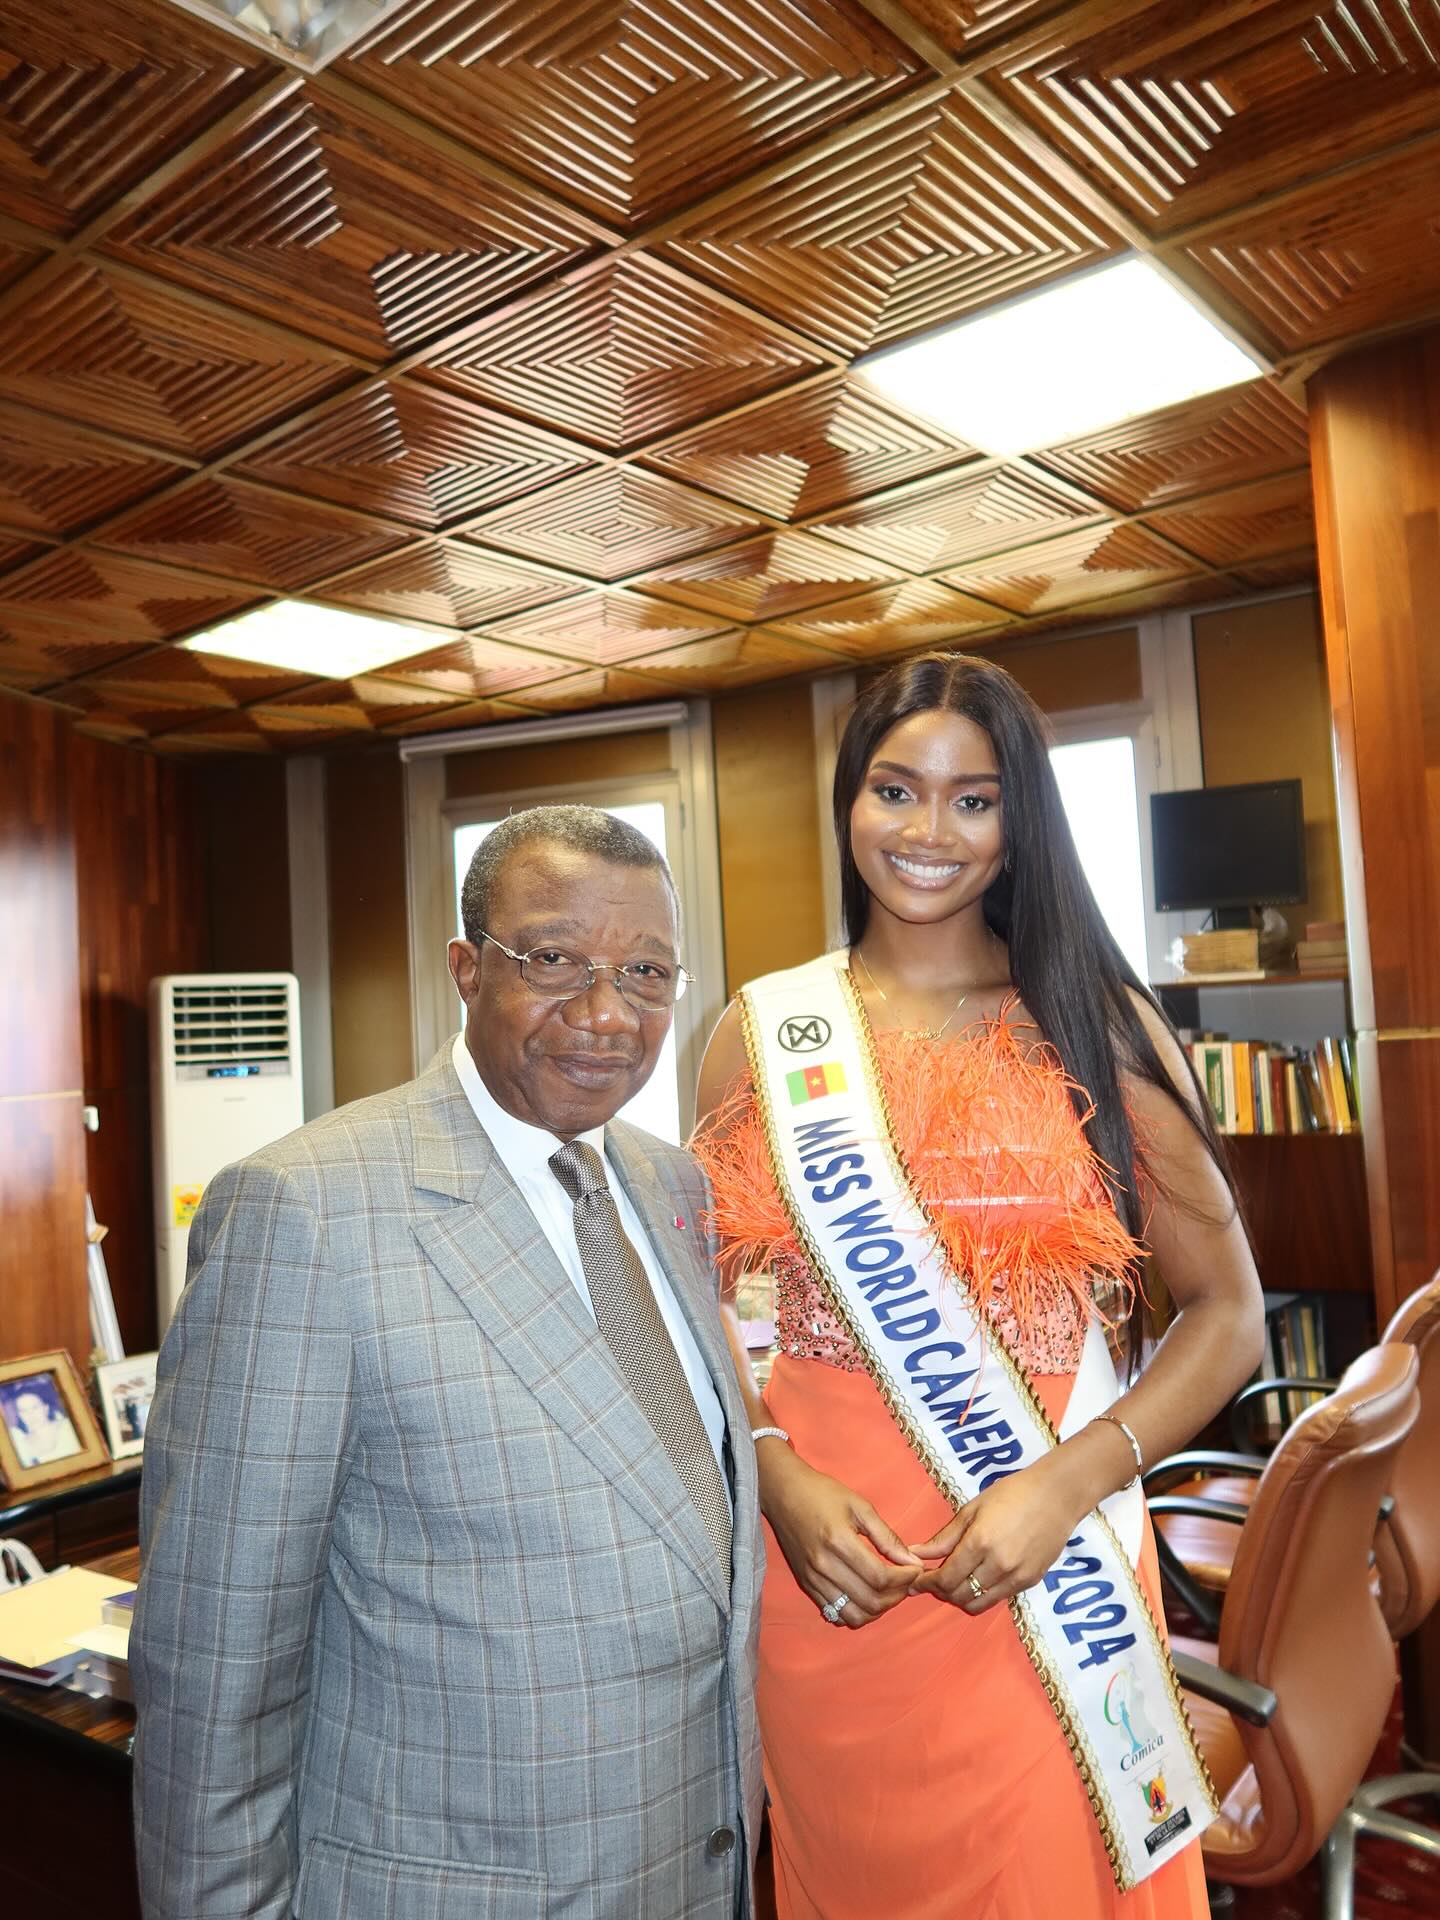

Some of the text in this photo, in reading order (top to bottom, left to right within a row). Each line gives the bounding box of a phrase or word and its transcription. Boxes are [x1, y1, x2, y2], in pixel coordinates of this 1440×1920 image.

[793, 1117, 872, 1204] MISS
[825, 1200, 941, 1342] WORLD
[1043, 1556, 1137, 1670] 2024
[1120, 1735, 1164, 1772] Comica
